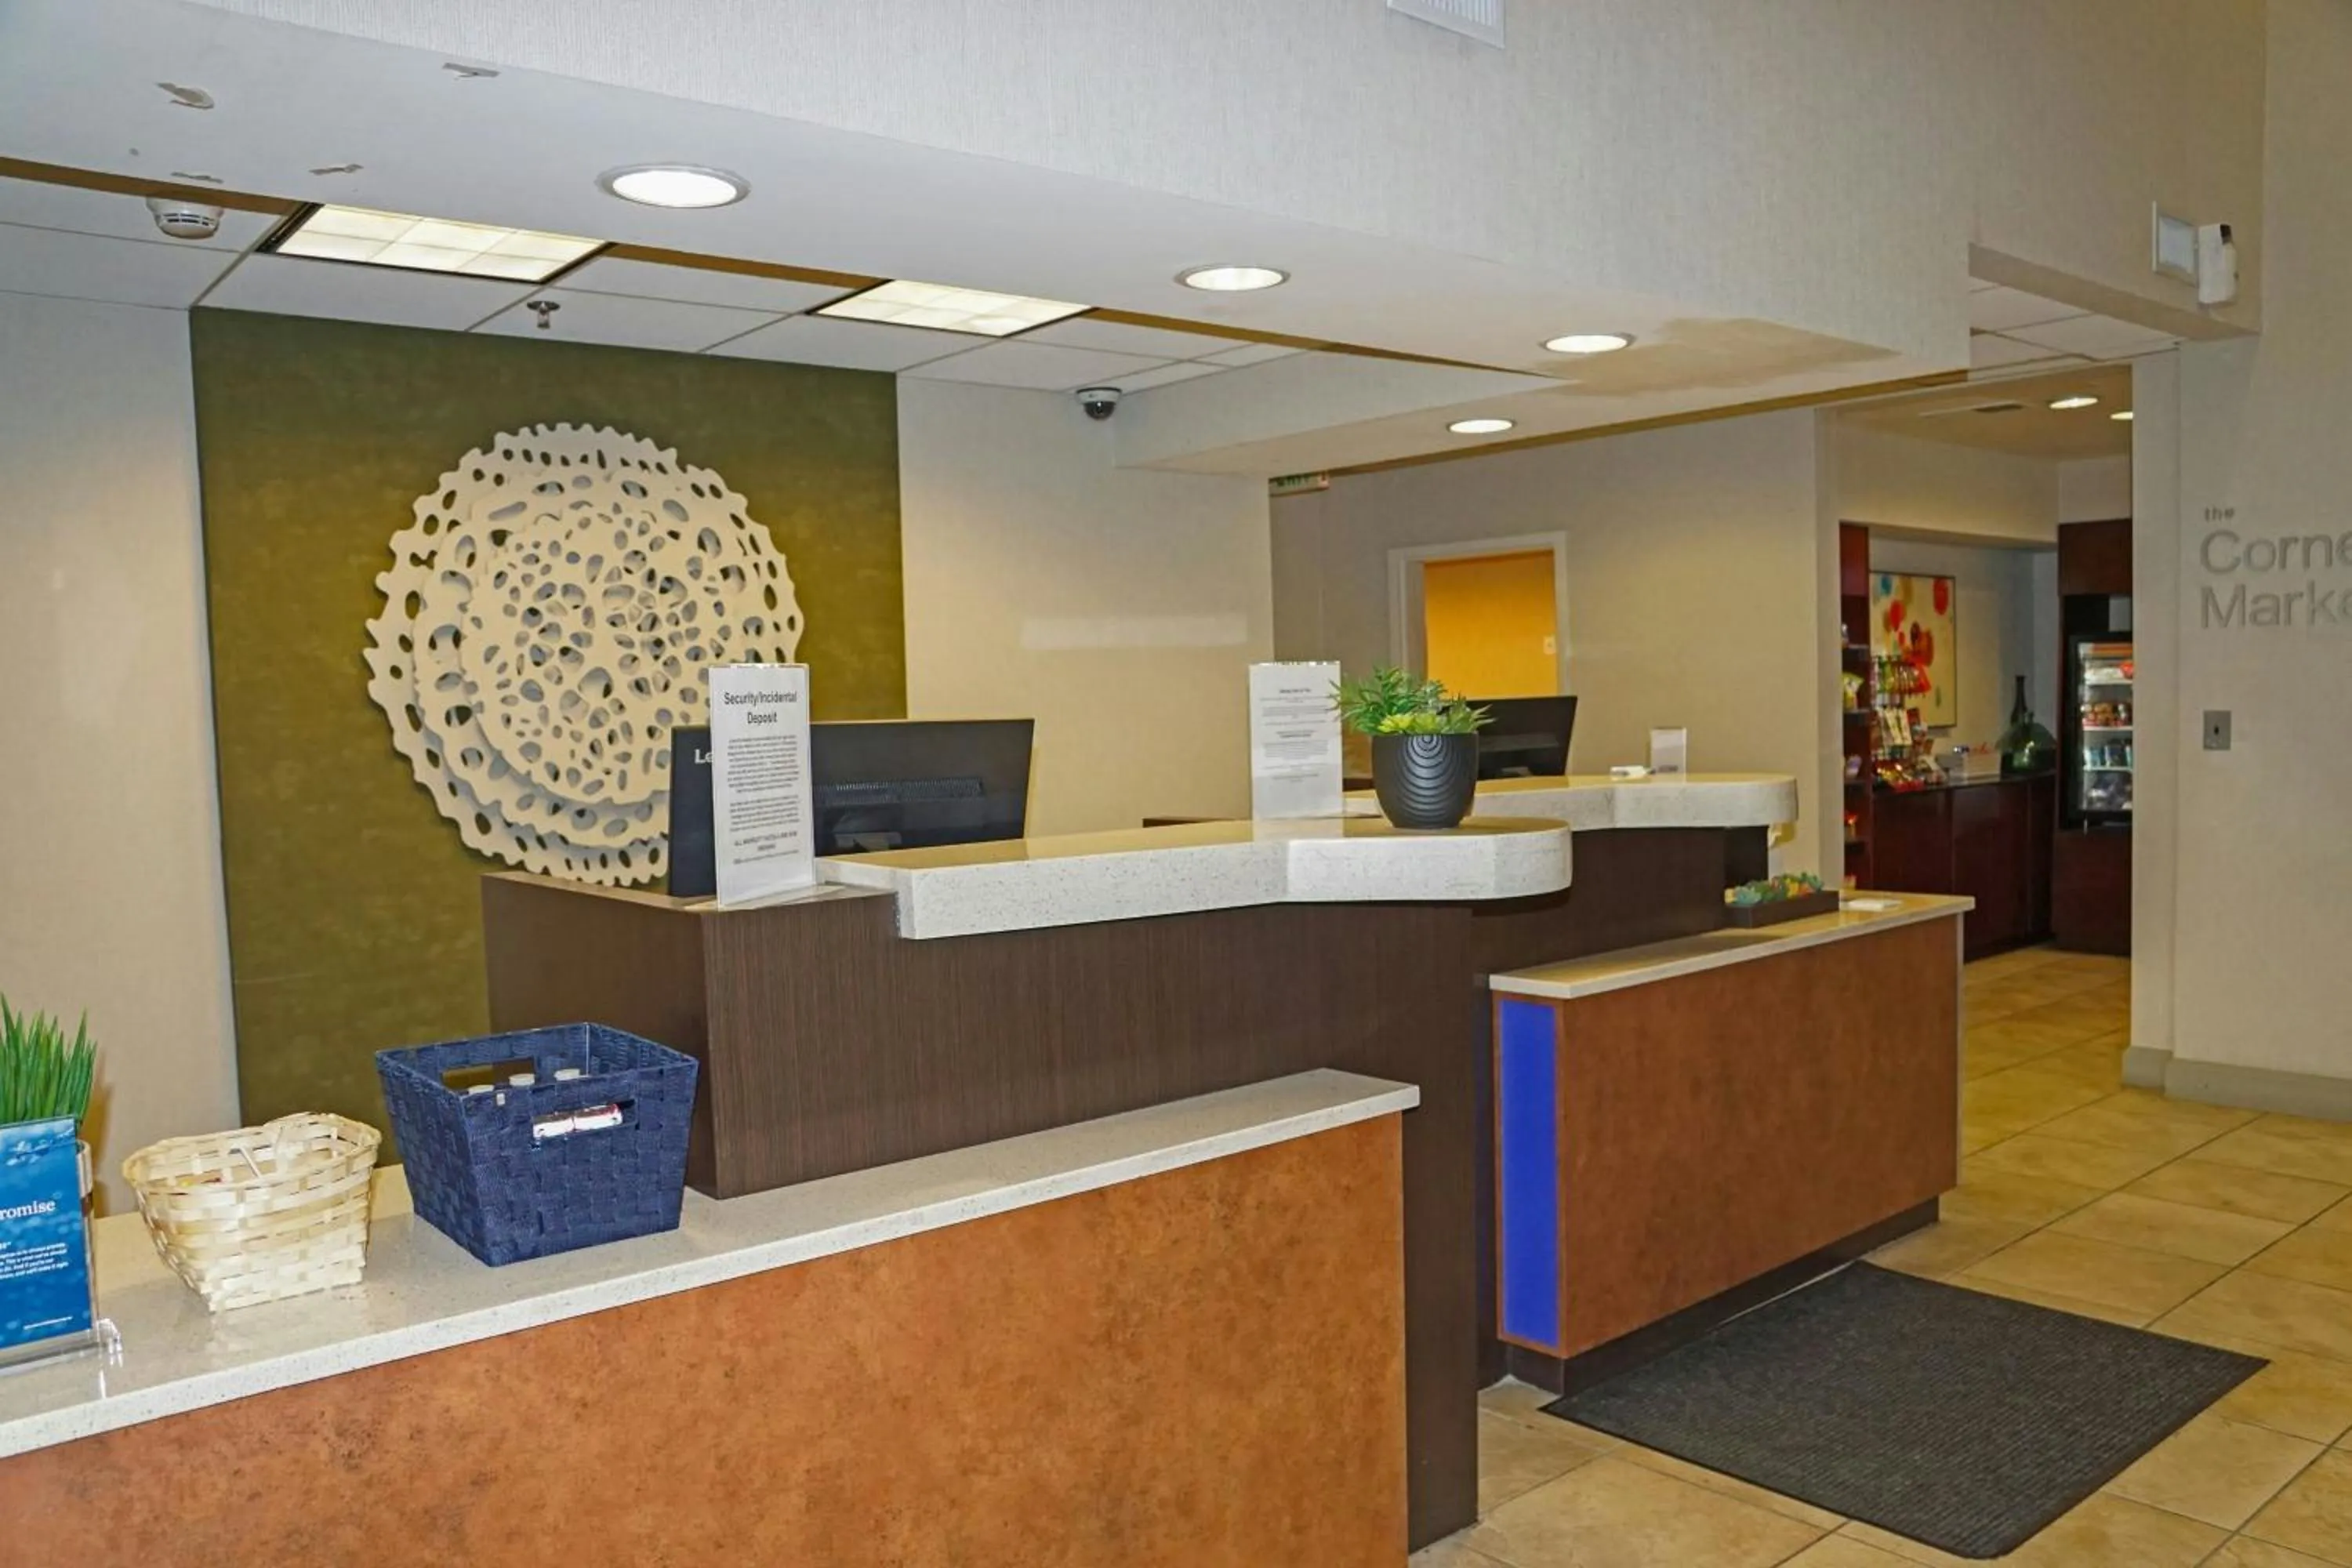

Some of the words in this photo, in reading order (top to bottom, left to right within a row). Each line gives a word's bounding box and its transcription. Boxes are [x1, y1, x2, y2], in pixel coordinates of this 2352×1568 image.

[2205, 506, 2235, 521] the
[724, 691, 798, 706] Security/Incidental
[747, 711, 778, 725] Deposit
